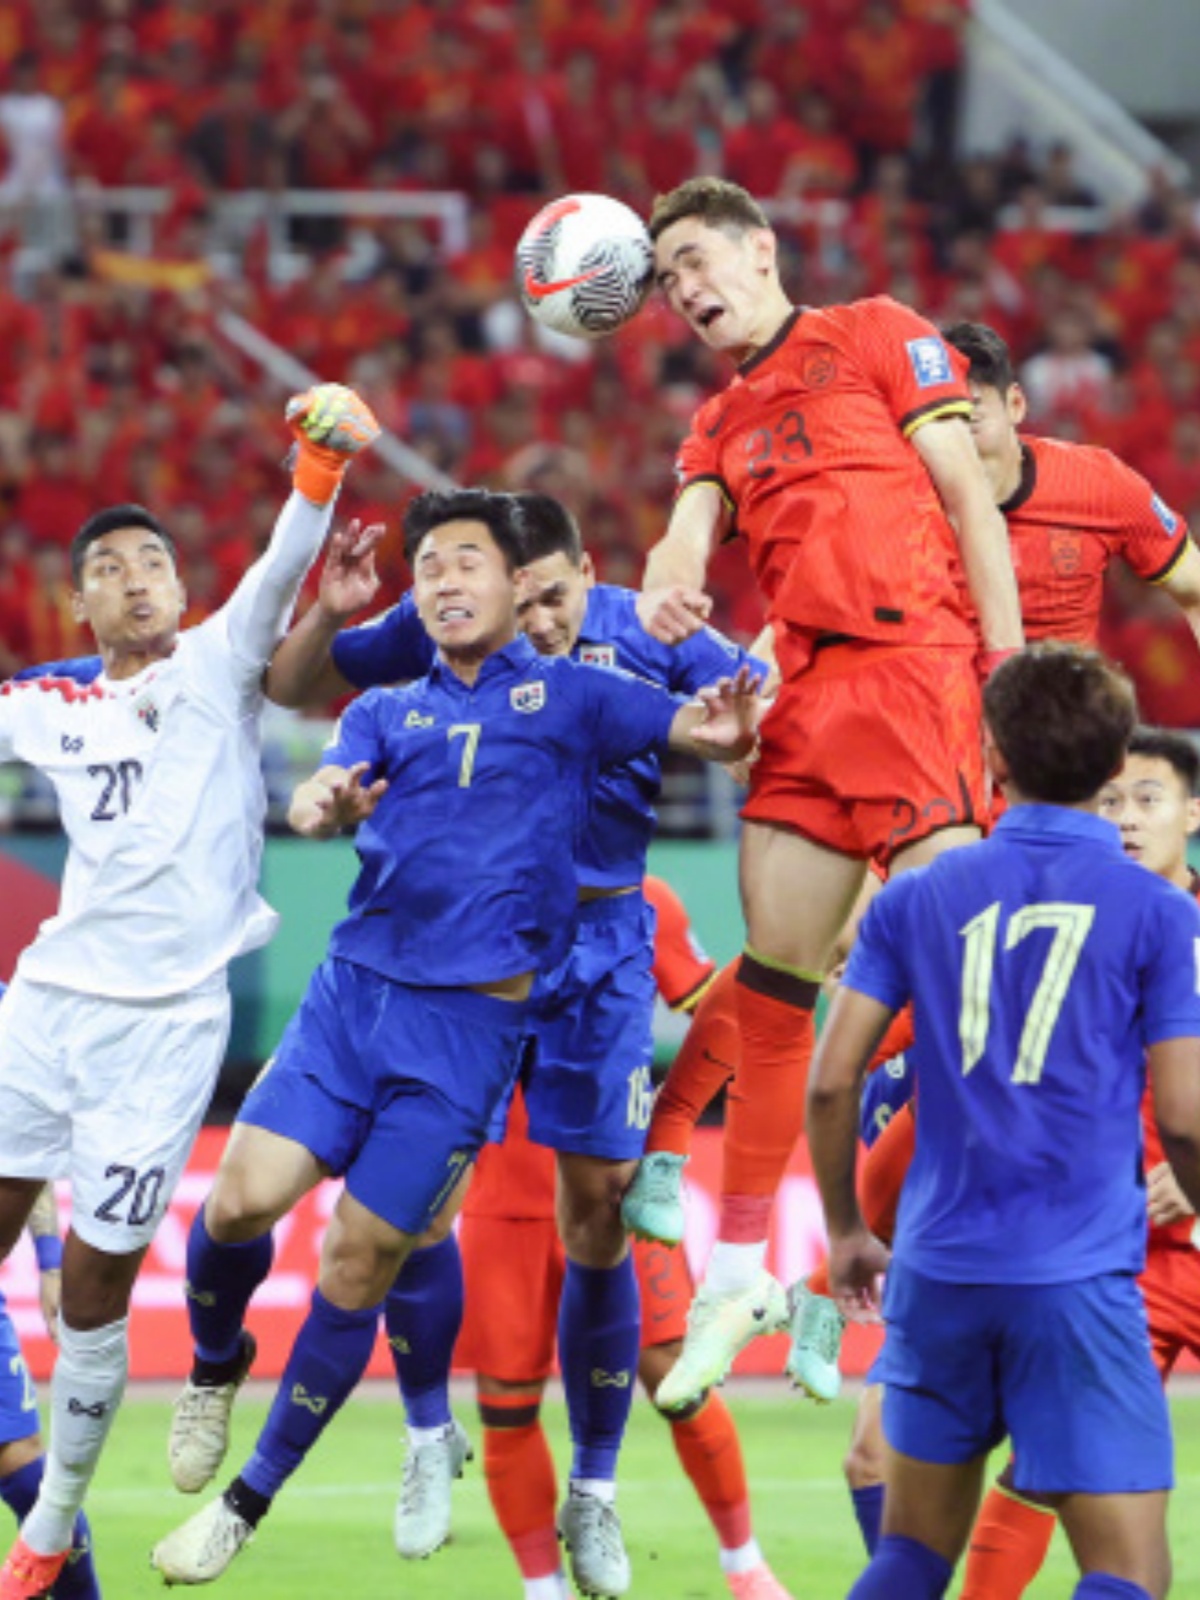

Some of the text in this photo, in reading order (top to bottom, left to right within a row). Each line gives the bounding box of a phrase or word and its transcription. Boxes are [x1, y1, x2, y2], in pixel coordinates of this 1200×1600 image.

[744, 409, 813, 480] 23
[447, 723, 482, 788] 7
[957, 900, 1097, 1086] 17
[93, 1163, 165, 1226] 20
